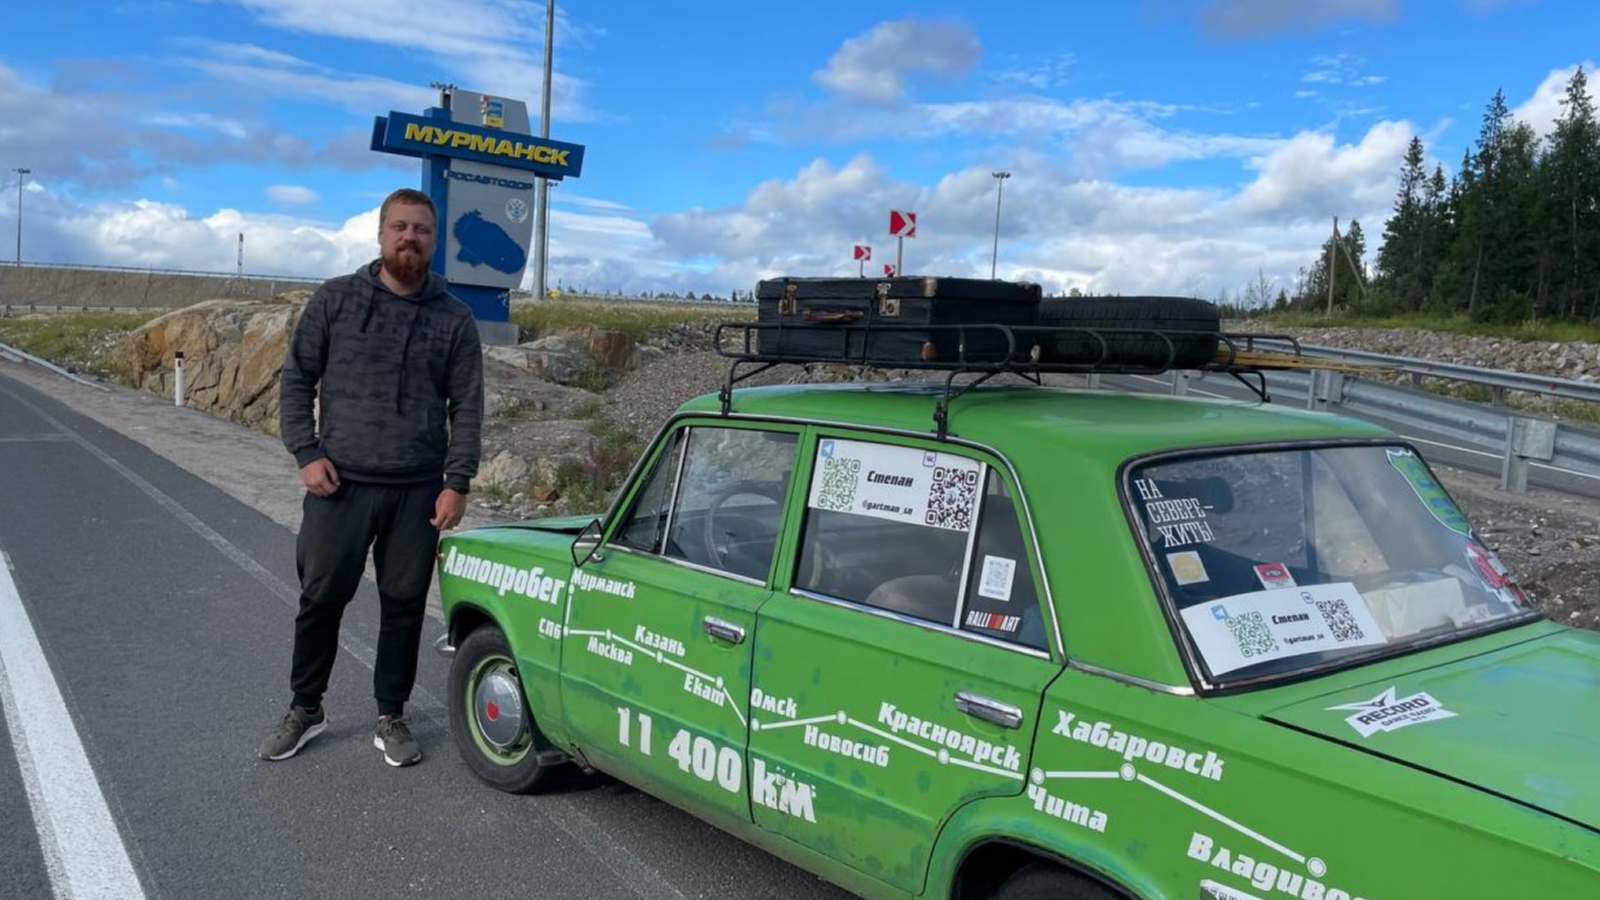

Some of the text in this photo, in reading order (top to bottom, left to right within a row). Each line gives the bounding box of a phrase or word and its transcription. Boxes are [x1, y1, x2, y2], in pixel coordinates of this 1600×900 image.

[405, 123, 570, 166] МУРМАНСК
[445, 169, 534, 190] РОСАВТОДОР
[867, 470, 914, 487] Степан
[1134, 478, 1163, 499] НА
[1157, 521, 1216, 548] ЖИТЬ!
[444, 546, 566, 605] Автопробег
[571, 568, 637, 599] Мурманск
[1271, 612, 1310, 625] Степан
[587, 636, 634, 666] Москва
[634, 624, 686, 657] Казань
[683, 672, 725, 707] Екат
[750, 688, 798, 719] Омск
[1356, 697, 1430, 726] RECORD
[617, 706, 652, 756] 11
[668, 728, 742, 793] 400
[803, 725, 890, 767] Новосиб
[877, 701, 1022, 771] Красноярск
[1051, 709, 1225, 781] Хабаровск
[1027, 783, 1108, 833] Чита
